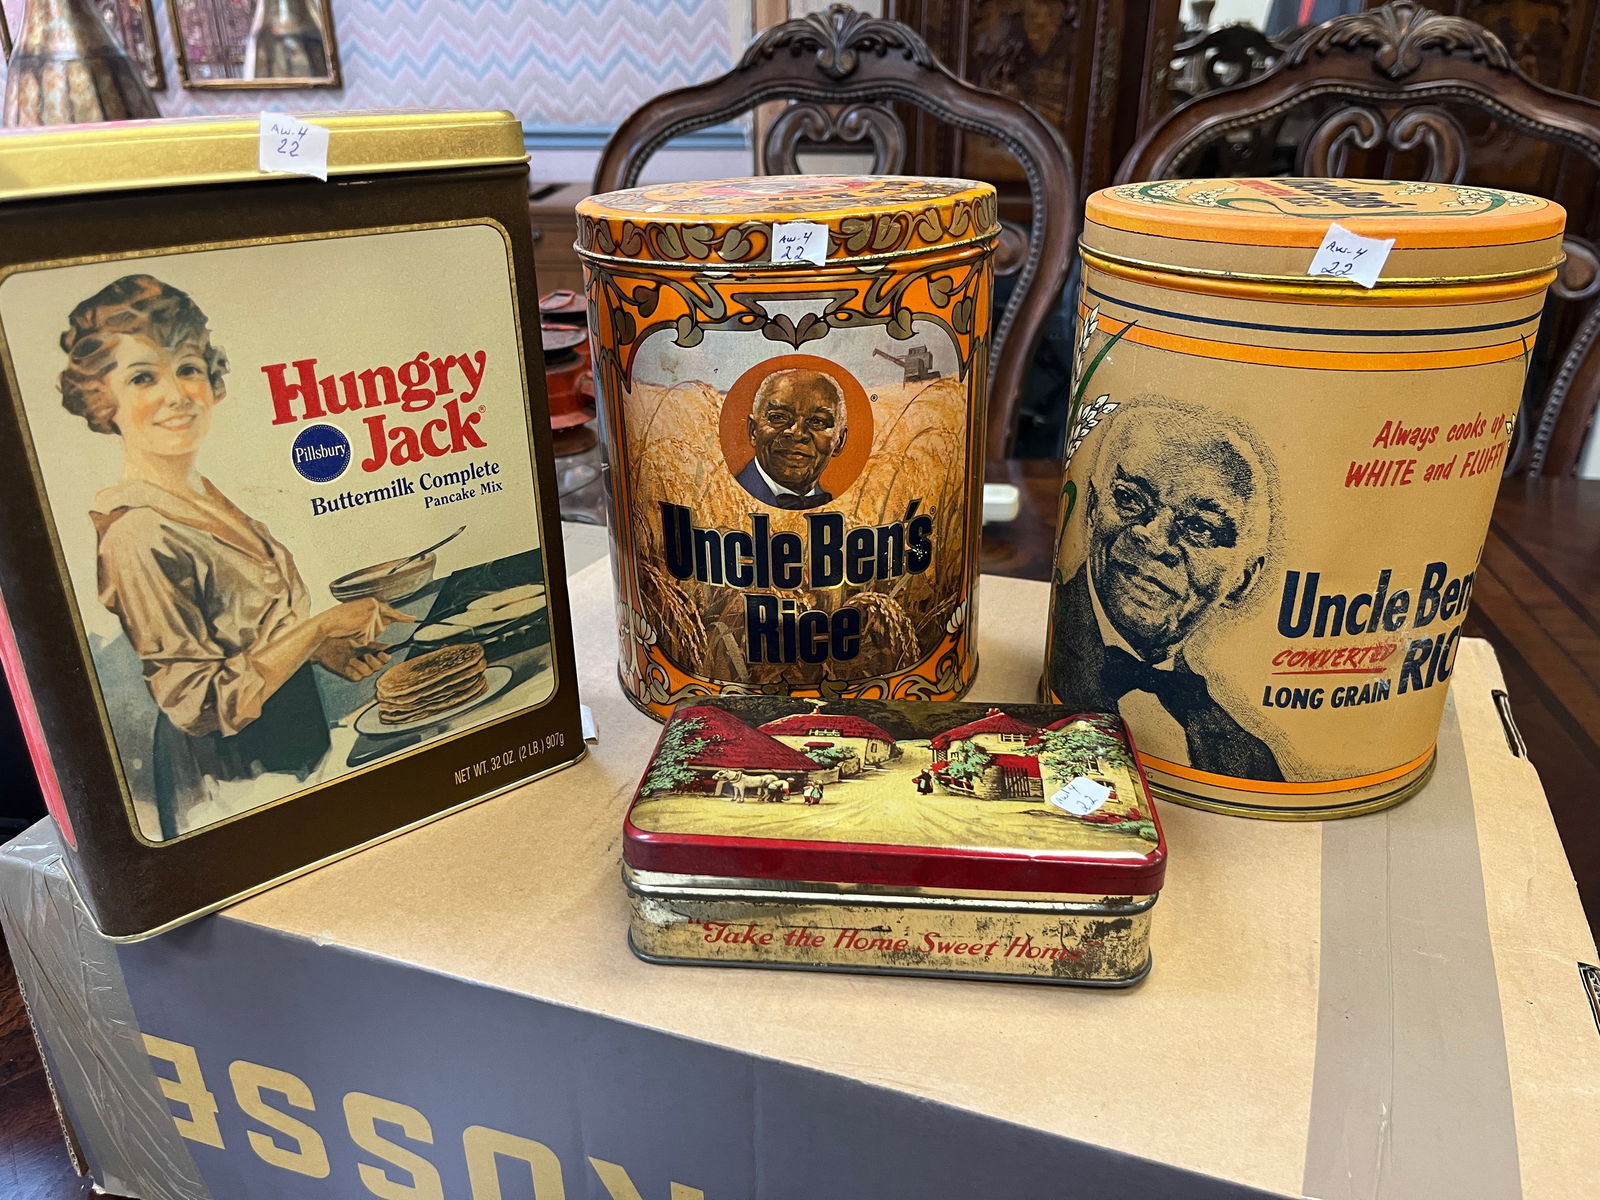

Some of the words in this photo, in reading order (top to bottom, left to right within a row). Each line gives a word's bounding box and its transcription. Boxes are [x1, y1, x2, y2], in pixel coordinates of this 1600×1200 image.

[277, 138, 300, 157] 22
[780, 245, 805, 260] 22
[1321, 261, 1353, 276] 22
[261, 350, 486, 425] Hungry
[361, 398, 488, 473] Jack
[1372, 420, 1440, 451] Always
[1446, 411, 1487, 442] cooks
[1490, 412, 1505, 440] up
[295, 444, 346, 463] Pillsbury
[1344, 459, 1417, 488] WHITE
[1423, 454, 1457, 483] and
[310, 478, 415, 516] Buttermilk
[419, 461, 500, 495] Complete
[424, 487, 476, 509] Pancake
[480, 480, 503, 496] Mix
[659, 501, 805, 590] Uncle
[803, 498, 933, 590] Ben's
[1277, 568, 1413, 638] Uncle
[741, 593, 861, 665] Rice
[1397, 625, 1462, 695] RIC
[1262, 685, 1325, 710] LONG
[1330, 678, 1392, 709] GRAIN
[454, 766, 472, 785] NET
[473, 760, 489, 778] WT.
[491, 755, 502, 772] 32
[502, 750, 516, 767] OZ.
[518, 745, 528, 763] (2
[528, 738, 545, 757] LB.)
[546, 731, 565, 751] 907g
[783, 926, 826, 948] the
[833, 927, 909, 951] Home
[917, 931, 1000, 957] Sweet
